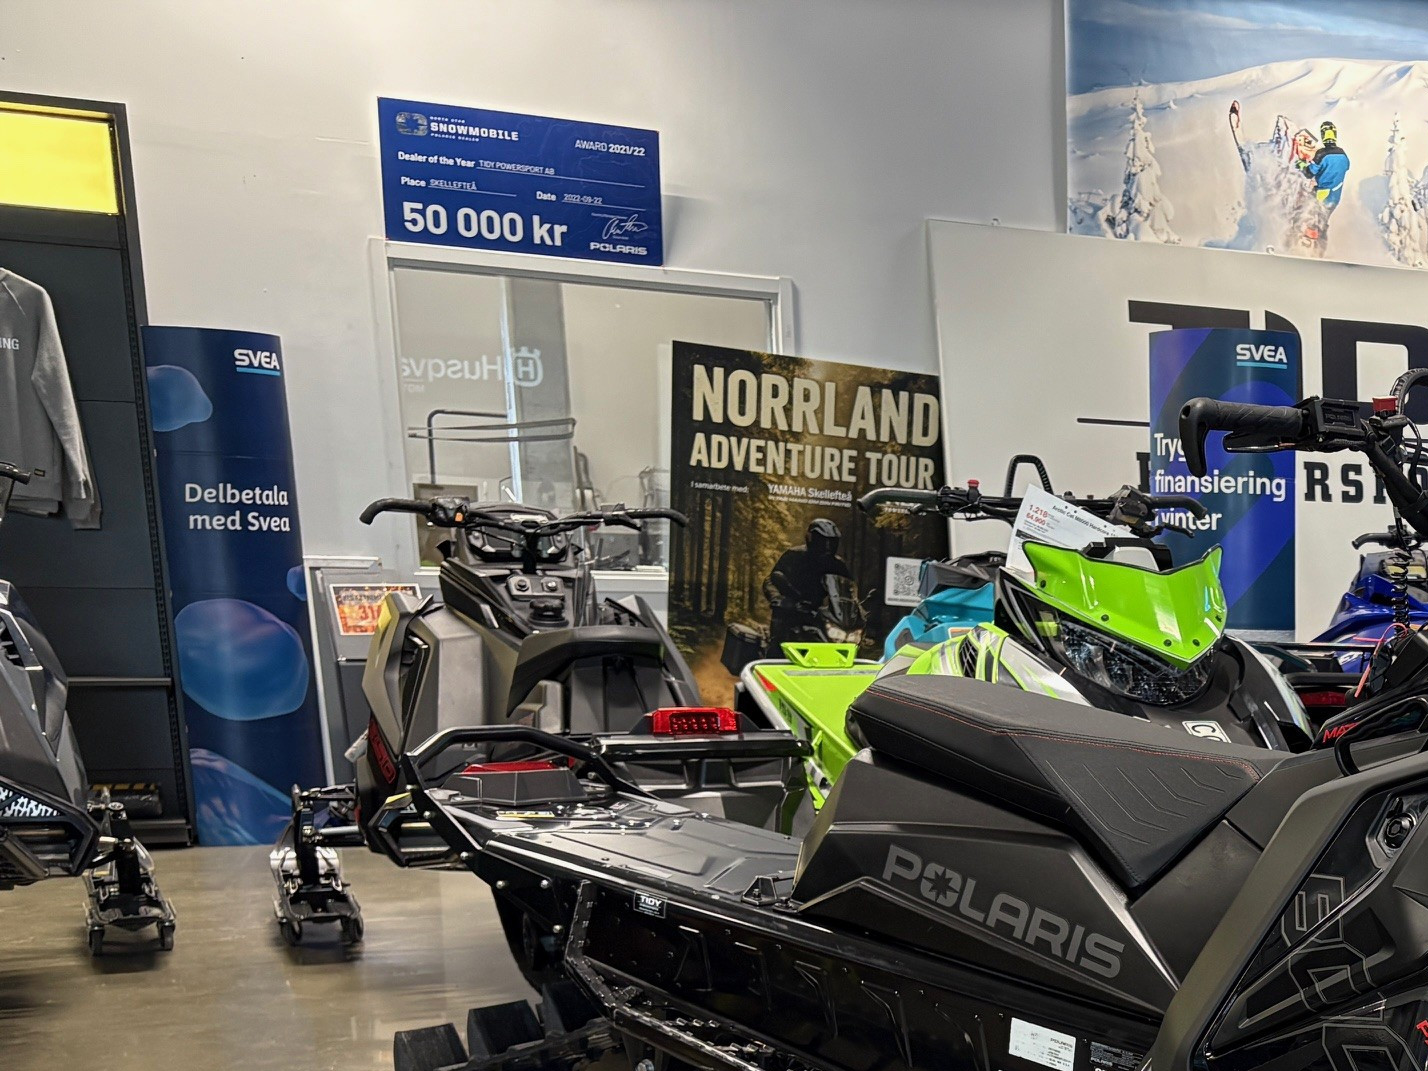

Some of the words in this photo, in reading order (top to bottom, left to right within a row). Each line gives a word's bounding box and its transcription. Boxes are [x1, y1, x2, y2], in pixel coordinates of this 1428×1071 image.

[430, 122, 519, 141] SNOWMOBILE
[575, 139, 607, 152] AWARD
[608, 143, 646, 156] 2021/22
[398, 151, 427, 163] Dealer
[428, 154, 439, 164] of
[440, 156, 454, 166] the
[455, 158, 476, 168] Year
[479, 159, 495, 169] TIDY
[495, 161, 544, 174] POWERSPORT
[400, 176, 426, 187] Place
[536, 191, 557, 201] Date
[402, 201, 448, 235] 50
[456, 207, 524, 243] 000
[532, 214, 568, 247] kr
[589, 241, 648, 255] POLARIS
[233, 348, 280, 370] SVEA
[1236, 344, 1288, 364] SVEA
[692, 364, 940, 447] NORRLAND
[689, 432, 858, 483] ADVENTURE
[865, 451, 935, 490] TOUR
[184, 483, 289, 506] Delbetala
[767, 483, 807, 497] YAMAHA
[807, 486, 853, 502] Skellefteå
[1155, 469, 1286, 502] finansiering
[188, 511, 242, 531] med
[247, 512, 290, 532] Svea
[882, 843, 1126, 979] POLARIS
